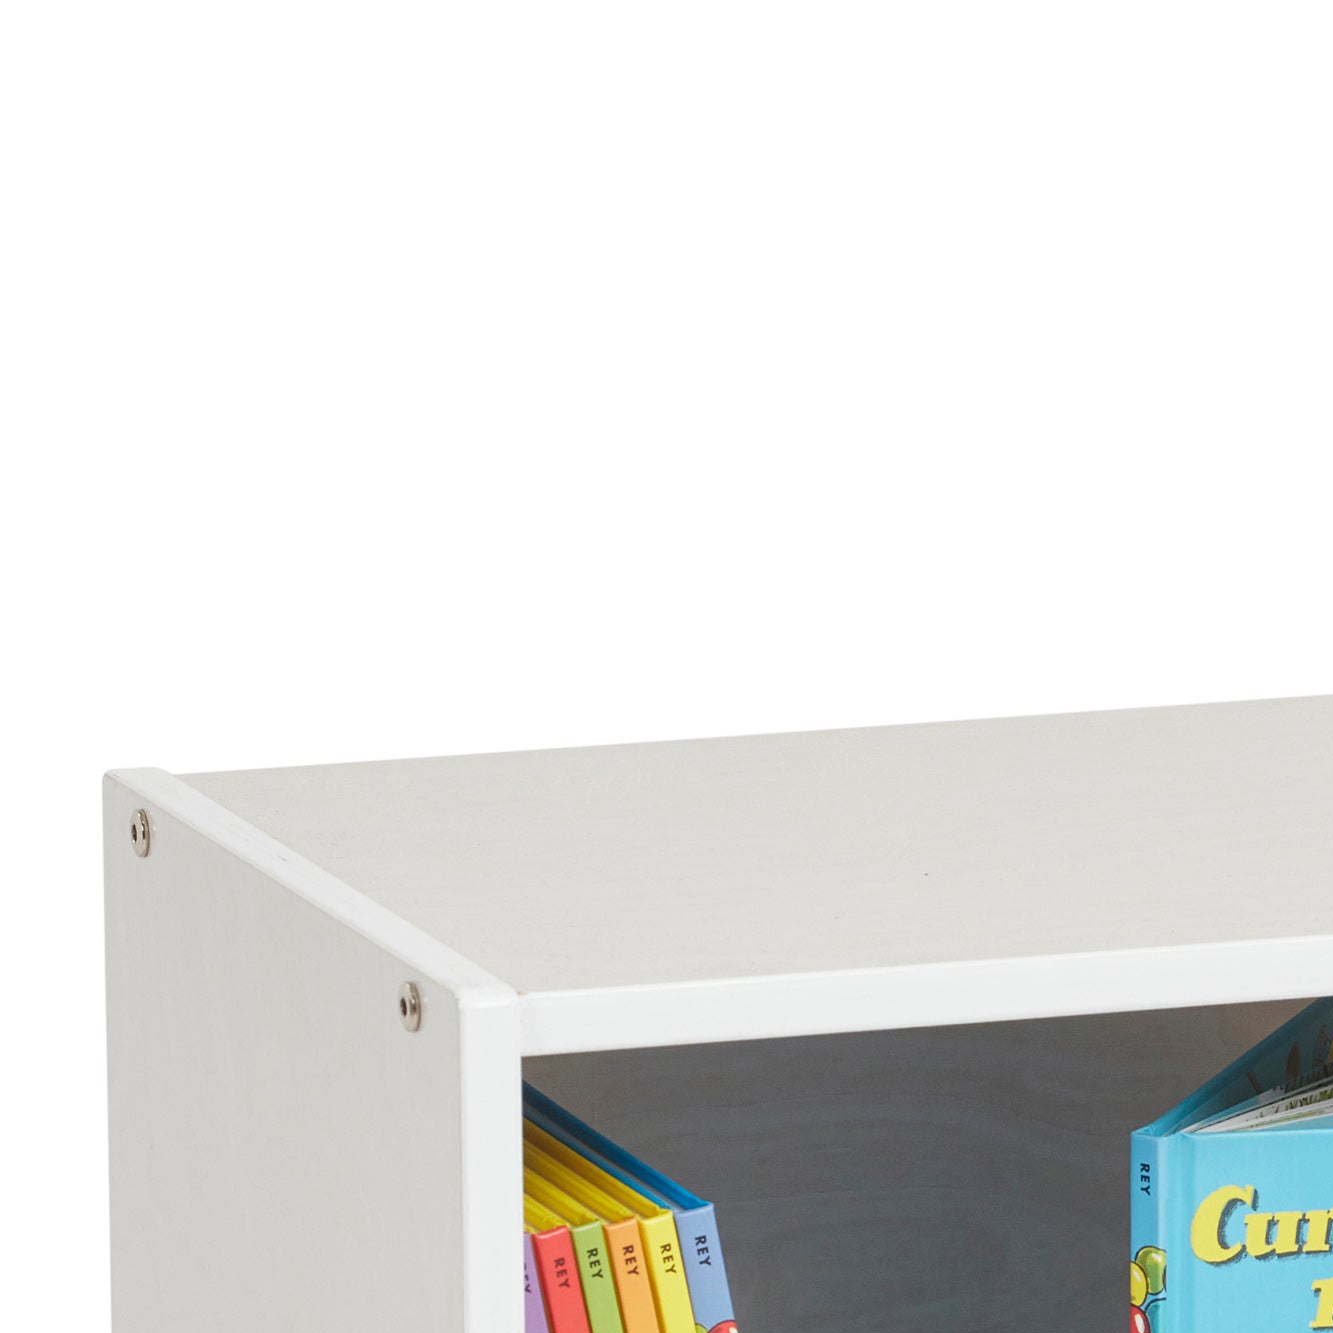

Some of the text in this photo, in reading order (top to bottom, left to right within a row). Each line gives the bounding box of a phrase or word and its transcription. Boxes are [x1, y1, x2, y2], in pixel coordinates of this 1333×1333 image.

[1139, 1162, 1151, 1196] REY
[586, 1247, 604, 1279] REY
[622, 1244, 639, 1276] REY
[660, 1243, 677, 1275] REY
[694, 1235, 711, 1266] REY
[554, 1257, 570, 1289] REY
